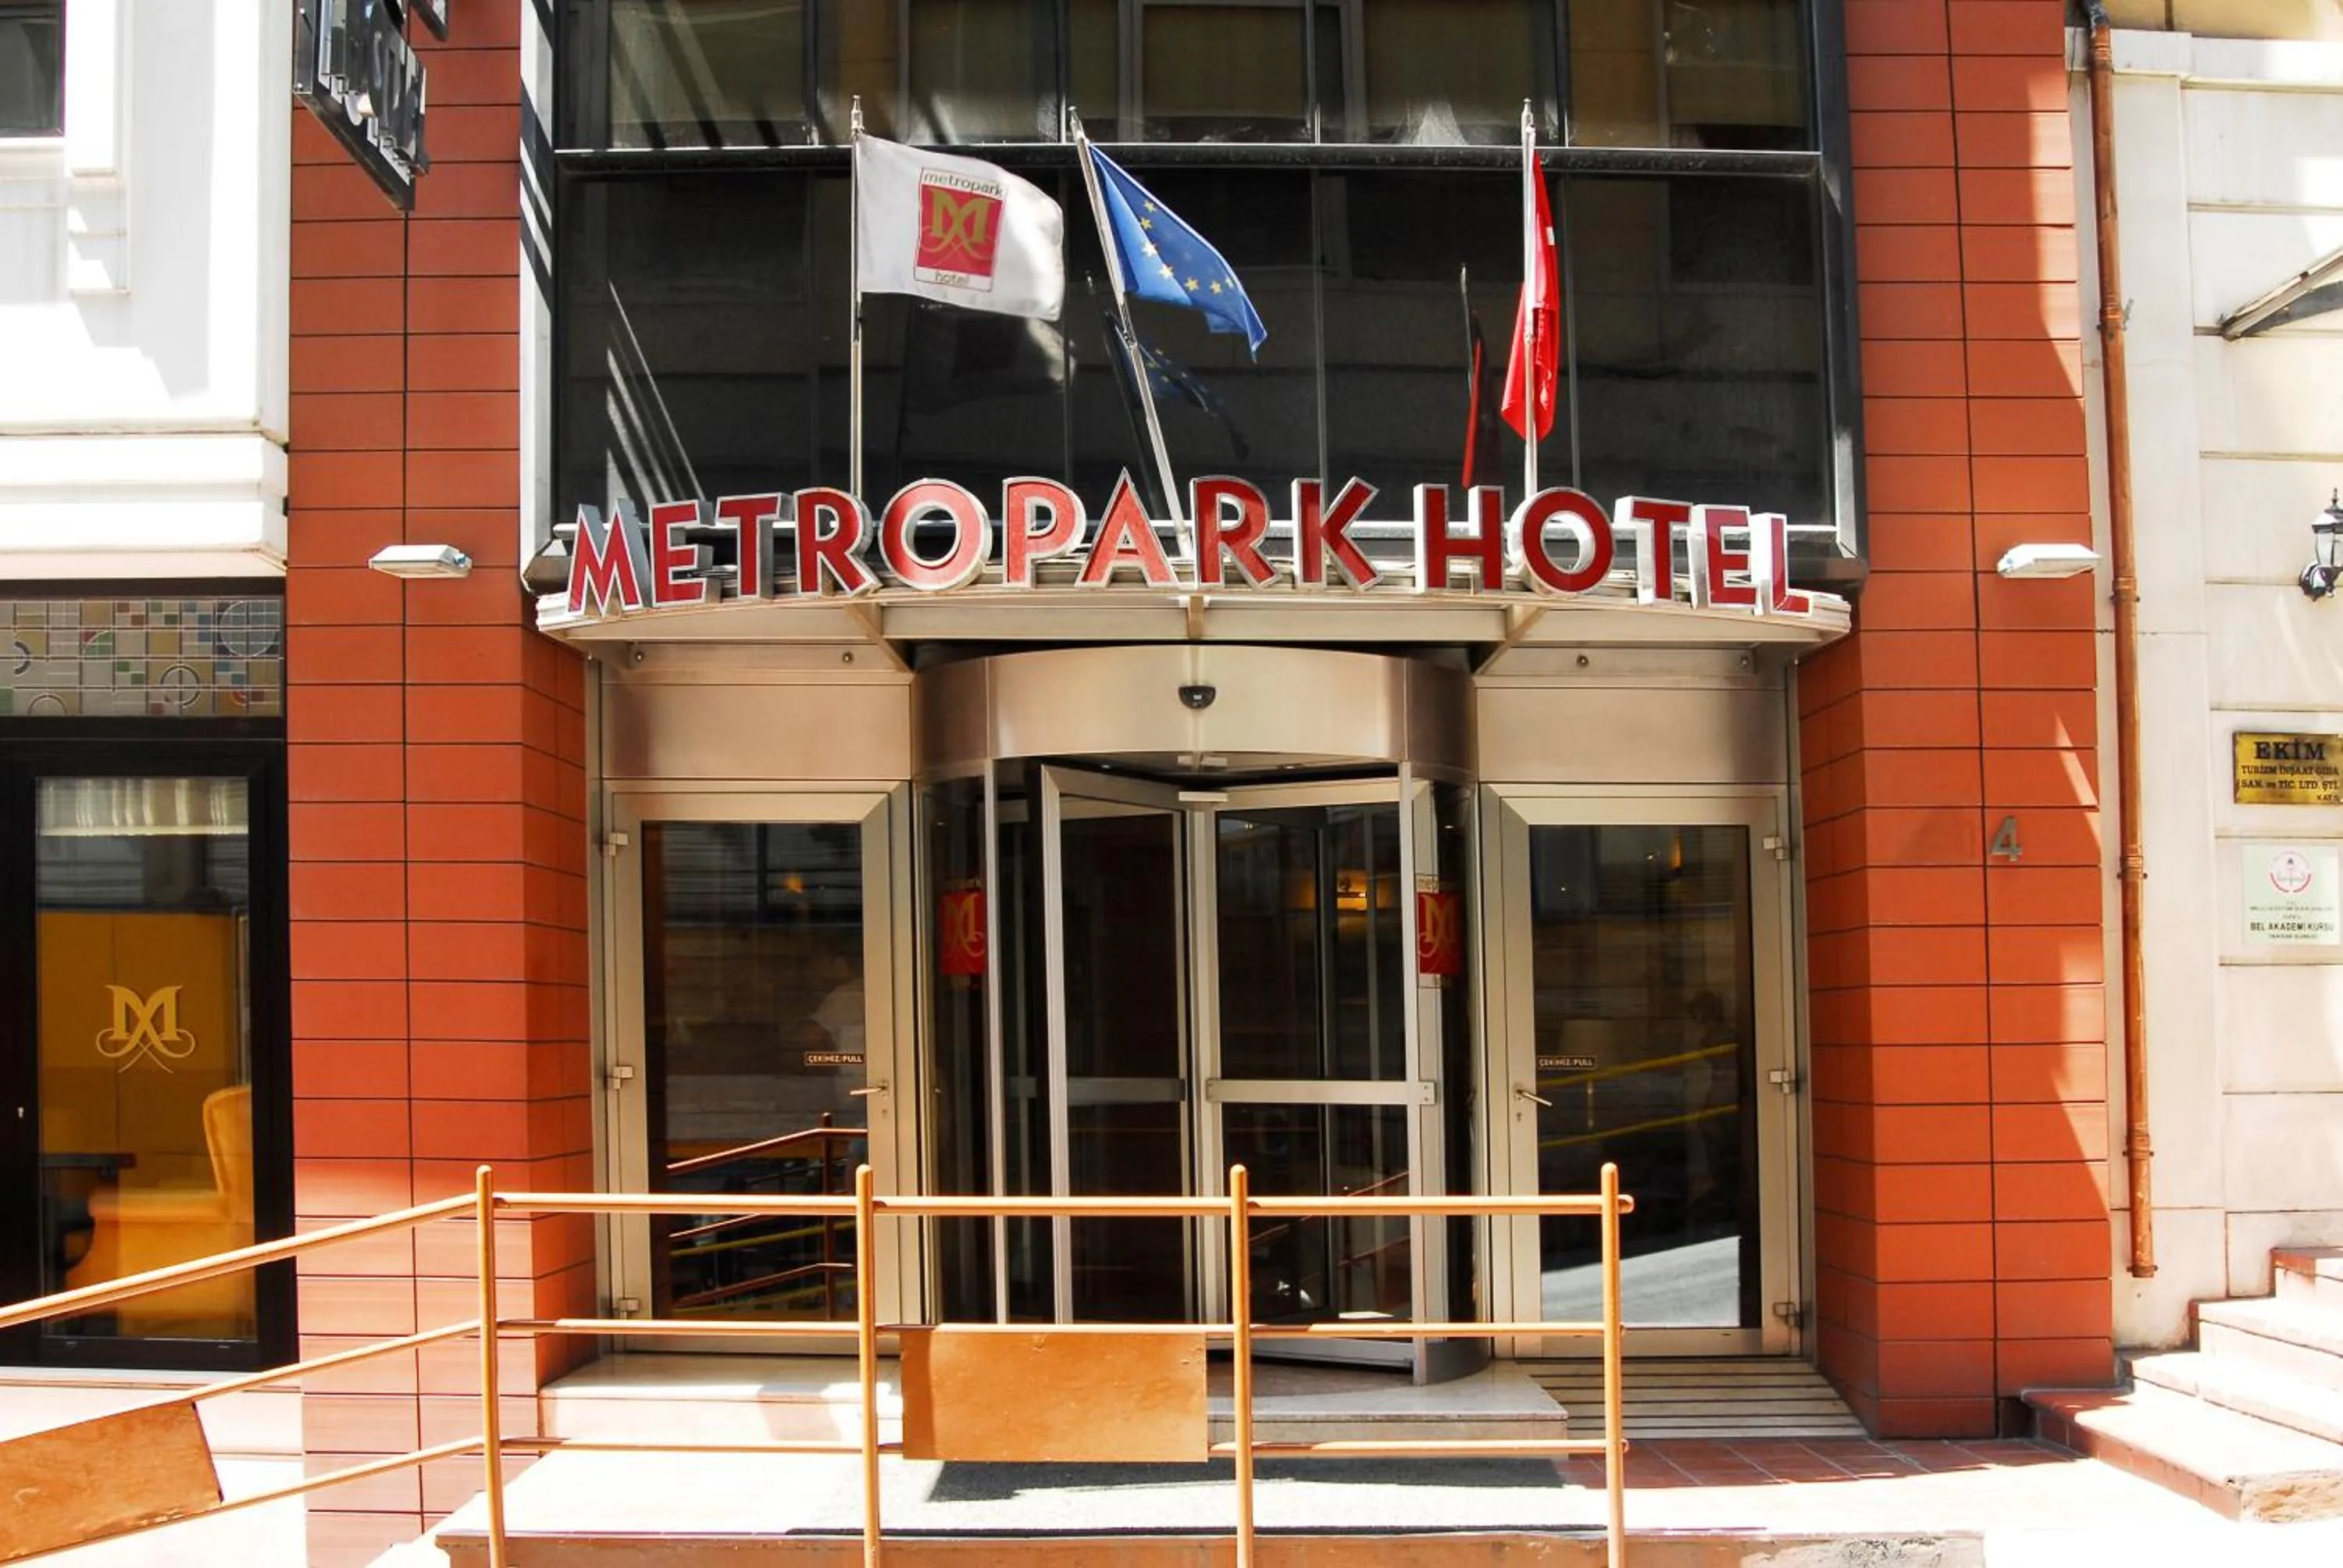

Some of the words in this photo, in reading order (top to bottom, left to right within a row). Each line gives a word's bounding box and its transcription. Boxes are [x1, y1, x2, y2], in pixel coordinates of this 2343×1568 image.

[924, 172, 1004, 198] metropark
[935, 272, 969, 287] hotel
[568, 467, 1379, 618] METROPARK
[1414, 483, 1814, 617] HOTEL
[2254, 739, 2325, 761] EKİM
[1991, 816, 2022, 862] 4
